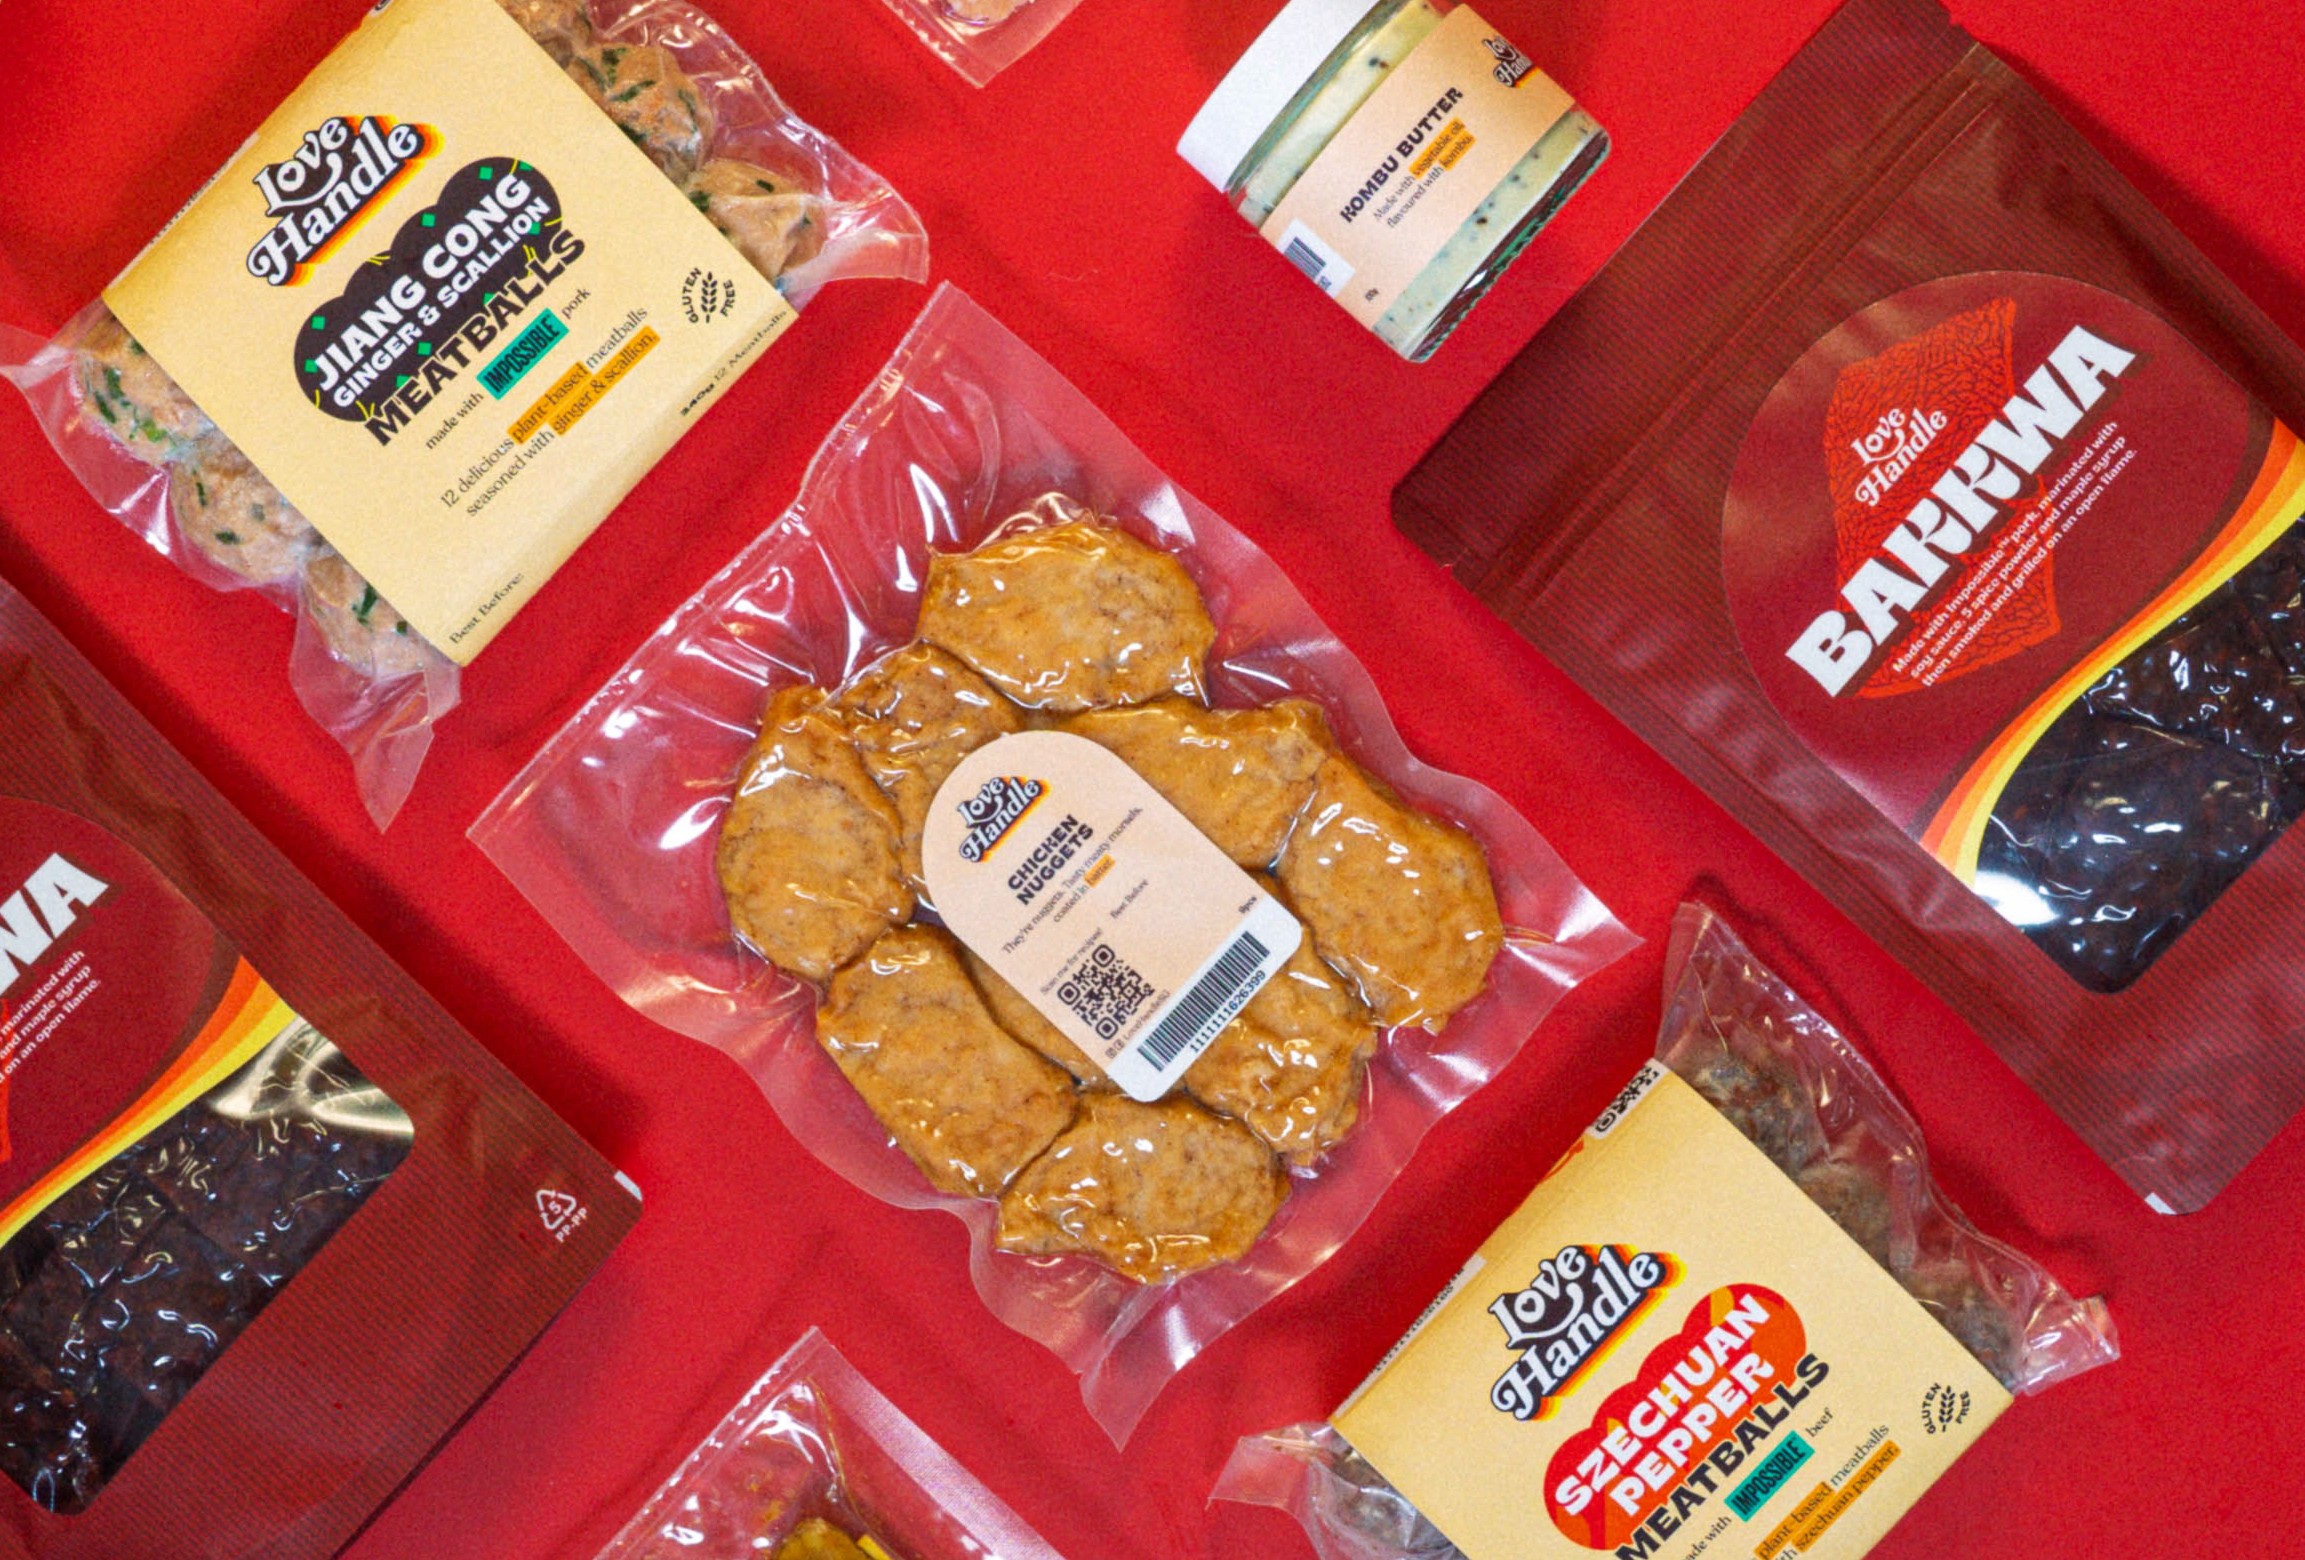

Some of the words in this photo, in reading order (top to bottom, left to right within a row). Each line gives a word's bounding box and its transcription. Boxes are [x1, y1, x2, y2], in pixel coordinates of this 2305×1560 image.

[246, 115, 422, 284] Handle
[252, 117, 345, 217] Love
[1339, 155, 1399, 222] KOMBU
[1395, 86, 1463, 157] BUTTER
[1372, 194, 1398, 218] Made
[1394, 175, 1416, 195] with
[1413, 134, 1451, 175] vegetable
[1386, 184, 1426, 226] flavoured
[1423, 166, 1444, 187] with
[1439, 136, 1473, 167] kombu.
[313, 274, 425, 390] JIANG
[422, 173, 530, 278] CONG
[333, 322, 422, 407] GINGER
[417, 304, 440, 326] &
[436, 196, 550, 308] SCALLION
[682, 266, 701, 323] GLUTEN
[720, 279, 735, 316] FREE
[362, 226, 587, 447] MEATBALLS
[425, 416, 458, 449] made
[456, 392, 484, 418] with
[561, 288, 590, 320] pork
[713, 367, 726, 381] 12
[728, 311, 786, 367] Meatballs
[440, 488, 460, 507] 12
[458, 438, 514, 493] delicious
[511, 362, 588, 443] plant-based
[585, 310, 647, 368] meatballs
[466, 454, 526, 514] seasoned
[522, 431, 554, 459] with
[553, 390, 592, 434] ginger
[589, 379, 606, 394] &
[603, 331, 656, 382] scallion.
[1849, 407, 1905, 467] Love
[1854, 407, 1945, 504] Handle
[1785, 325, 2136, 697] BAKKWA
[1892, 639, 1924, 672] Made
[1922, 612, 1949, 639] with
[2009, 511, 2042, 543] pork,
[2037, 446, 2094, 510] marinated
[2091, 422, 2117, 449] with
[1910, 654, 1934, 677] soy
[1929, 616, 1965, 655] sauce,
[1960, 607, 1972, 617] 5
[1970, 577, 1999, 609] spice
[1998, 533, 2038, 580] powder
[2038, 507, 2061, 534] and
[2058, 471, 2093, 510] maple
[2091, 436, 2125, 472] syrup
[449, 616, 480, 643] Best
[477, 573, 522, 616] Before:
[1921, 657, 1951, 686] then
[1949, 608, 1992, 658] smoked
[1991, 584, 2013, 611] and
[2011, 546, 2047, 589] grilled
[2045, 531, 2062, 548] on
[2060, 515, 2077, 532] an
[2075, 484, 2104, 515] open
[2099, 447, 2138, 485] flame.
[955, 776, 1002, 827] Love
[959, 776, 1040, 861] Handle
[1002, 922, 1033, 953] They're
[1031, 891, 1064, 924] nuggets.
[1061, 868, 1086, 888] Tasty
[1084, 842, 1110, 866] meaty
[1007, 814, 1078, 889] CHICKEN
[1016, 823, 1093, 905] NUGGETS
[1109, 902, 1126, 918] Best
[1123, 879, 1148, 903] Before
[1053, 892, 1081, 922] coated
[1076, 884, 1088, 894] in
[0, 973, 59, 1035] marinated
[56, 950, 84, 976] with
[4, 1057, 20, 1074] on
[20, 1041, 36, 1058] an
[35, 1012, 65, 1042] open
[61, 978, 101, 1013] flame.
[19, 999, 56, 1036] maple
[55, 965, 90, 1000] syrup
[1189, 969, 1265, 1052] 1111111626399
[548, 1201, 562, 1215] 5
[555, 1206, 587, 1243] PP-PP
[1486, 1244, 1585, 1347] Love
[1489, 1242, 1659, 1418] Handle
[1554, 1293, 1769, 1515] SZECHUAN
[1609, 1352, 1774, 1516] PEPPER
[1921, 1381, 1941, 1433] GLUTEN
[1955, 1391, 1969, 1423] FREE
[1613, 1352, 1833, 1560] MEATBALLS
[1683, 1544, 1705, 1560] ade
[1704, 1516, 1732, 1541] with
[1804, 1406, 1833, 1437] beef
[1758, 1482, 1832, 1560] plant-based
[1829, 1424, 1889, 1486] meatballs
[1795, 1491, 1853, 1550] szechuan
[1851, 1446, 1898, 1494] pepper.
